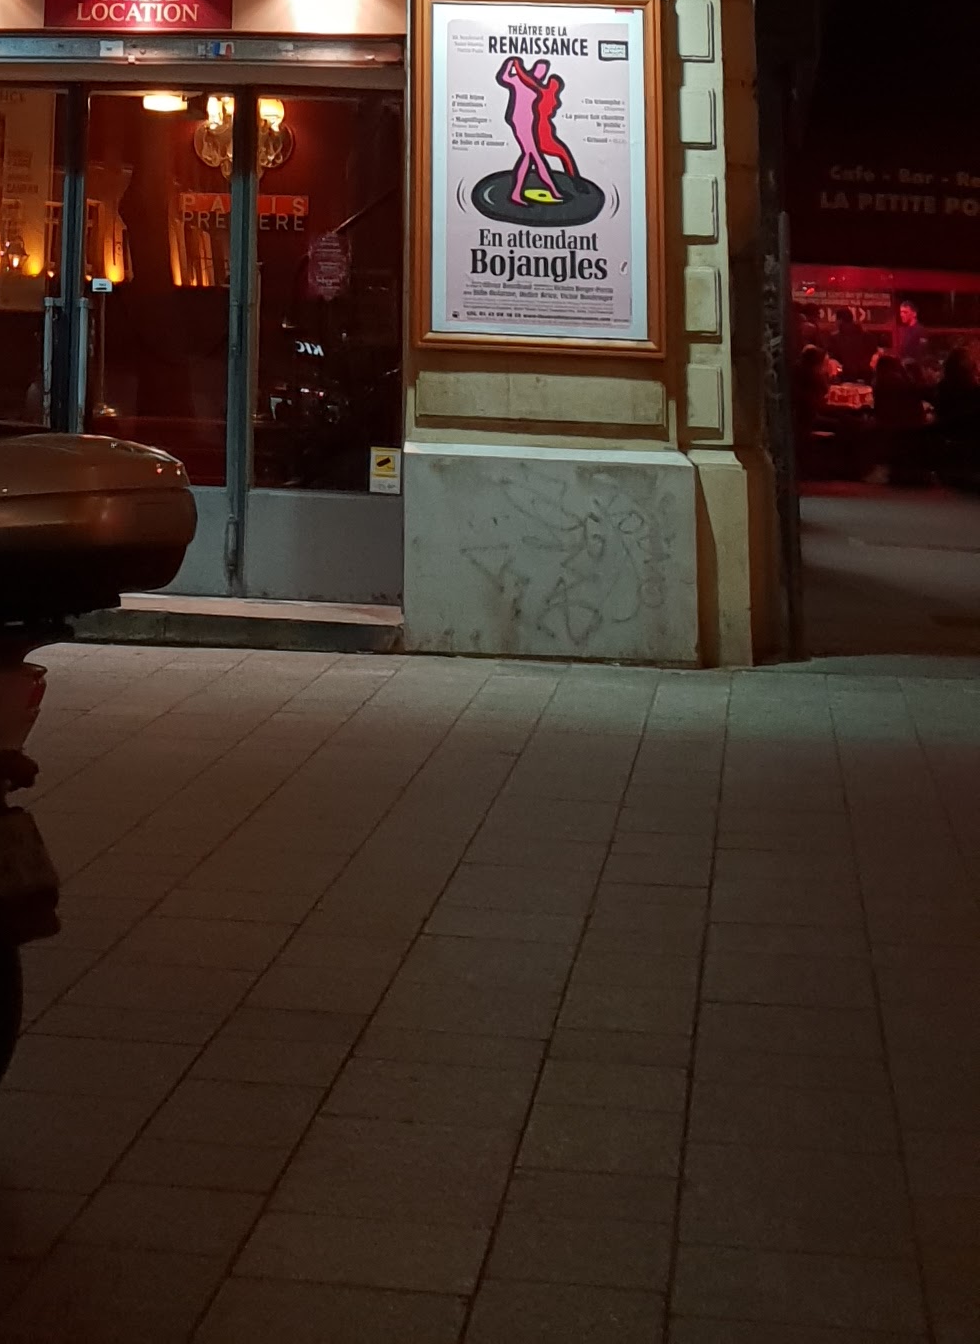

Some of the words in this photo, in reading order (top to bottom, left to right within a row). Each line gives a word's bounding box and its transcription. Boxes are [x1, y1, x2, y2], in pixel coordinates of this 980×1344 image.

[76, 1, 200, 25] LOCATION
[545, 26, 555, 36] DE
[557, 26, 567, 37] LA
[488, 36, 589, 57] RENAISSANCE
[181, 194, 306, 216] PAIS
[819, 190, 850, 209] LA
[857, 192, 937, 214] PETITE
[182, 212, 306, 232] PREERE
[478, 228, 503, 248] En
[507, 229, 599, 252] attendant
[470, 247, 609, 283] Bojangles
